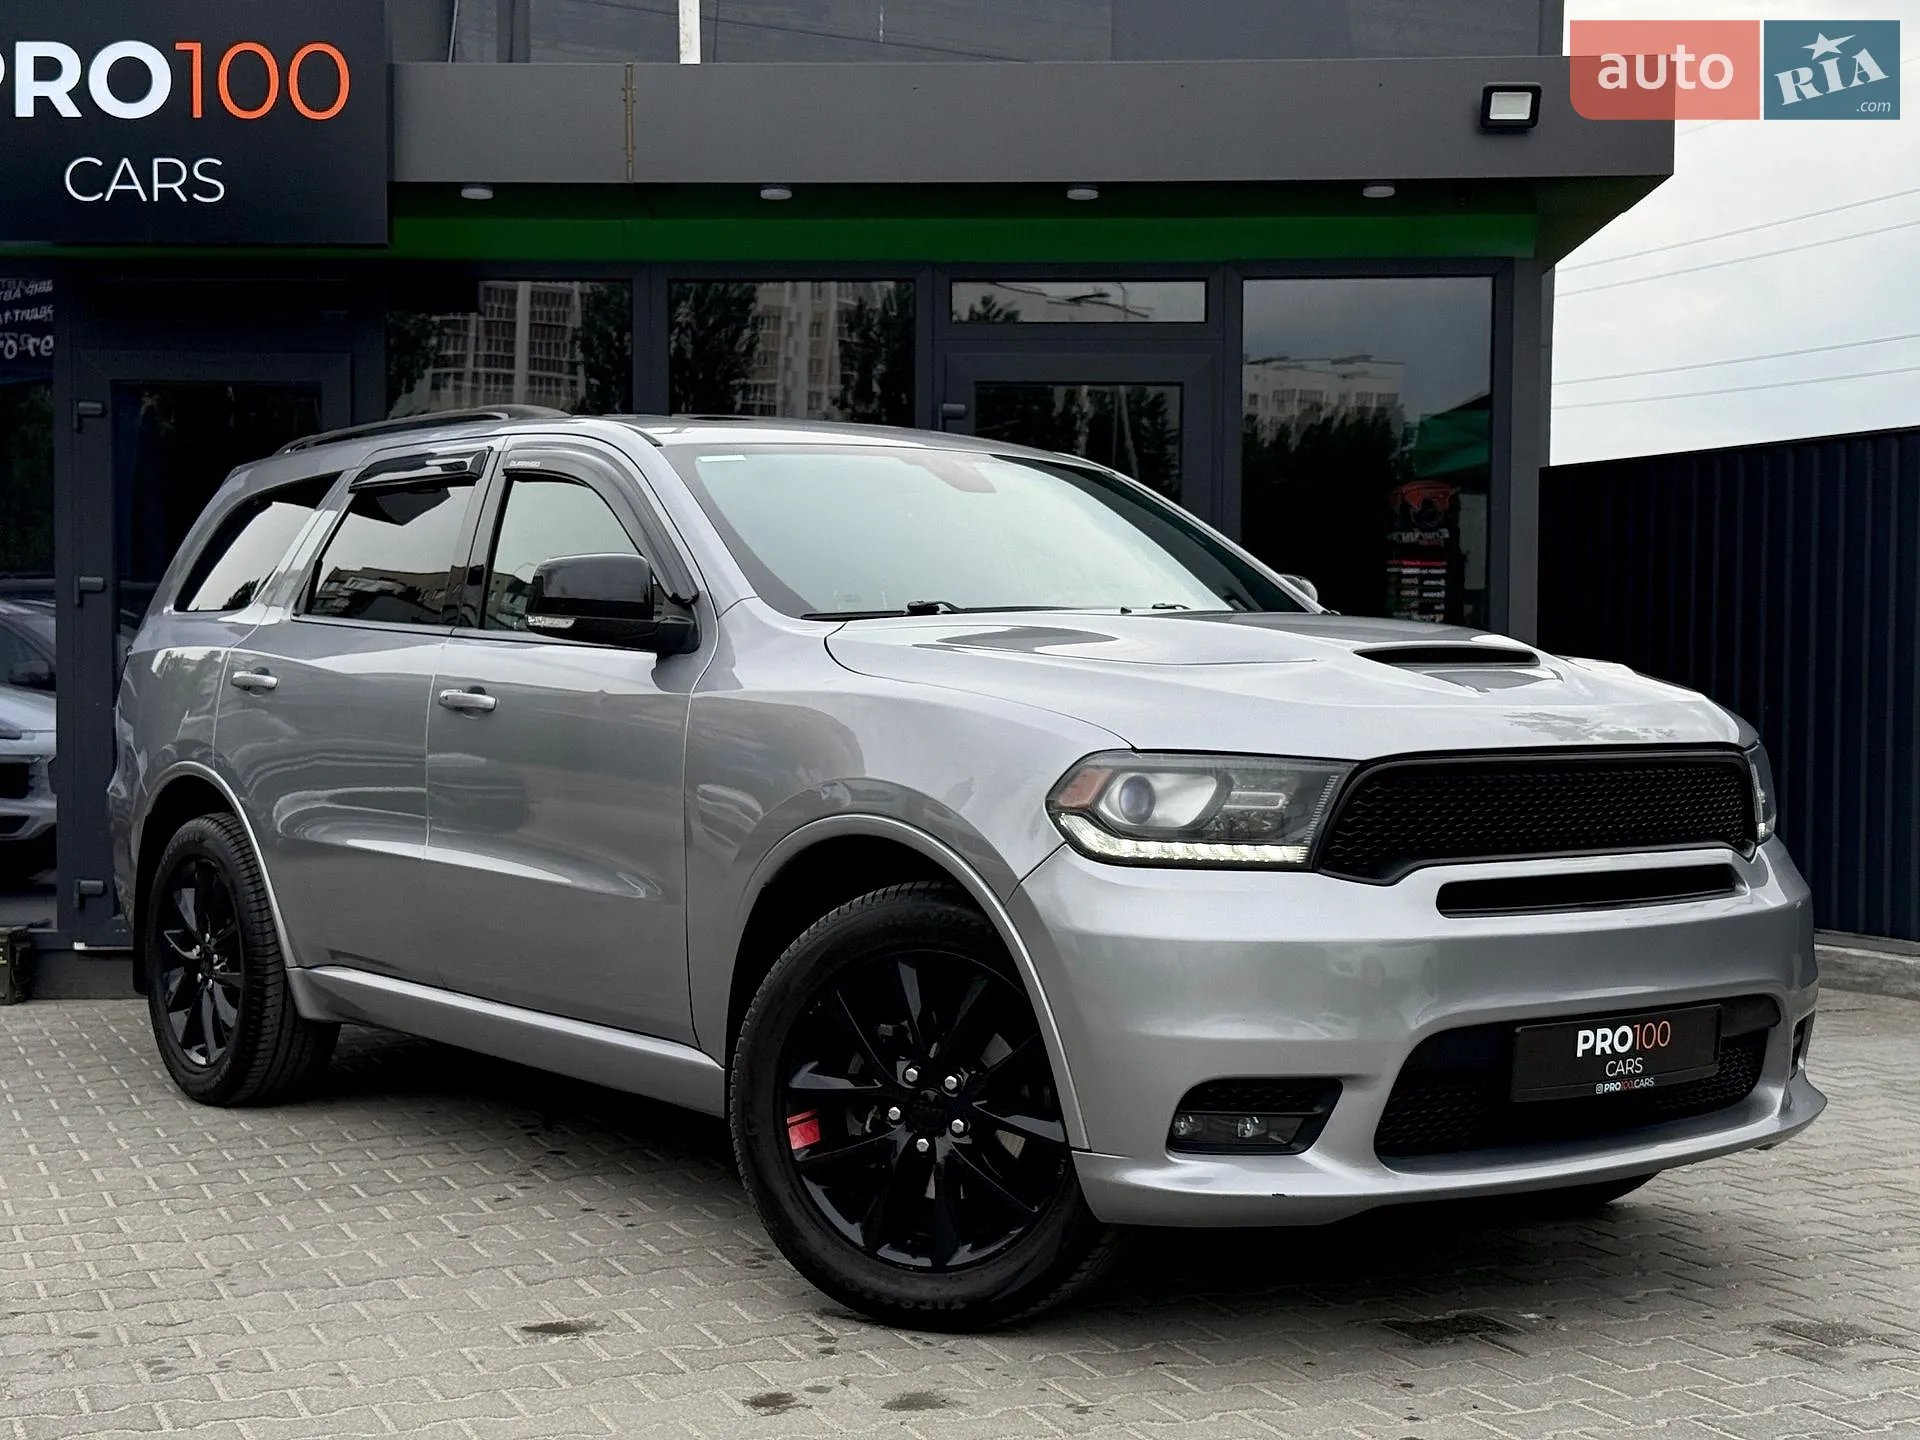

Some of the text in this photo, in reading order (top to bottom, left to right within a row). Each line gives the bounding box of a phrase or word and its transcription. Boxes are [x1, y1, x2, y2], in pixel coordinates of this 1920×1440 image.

[0, 40, 350, 120] RO100
[64, 156, 226, 203] CARS
[1577, 1021, 1671, 1057] PRO100
[1605, 1057, 1644, 1078] CARS
